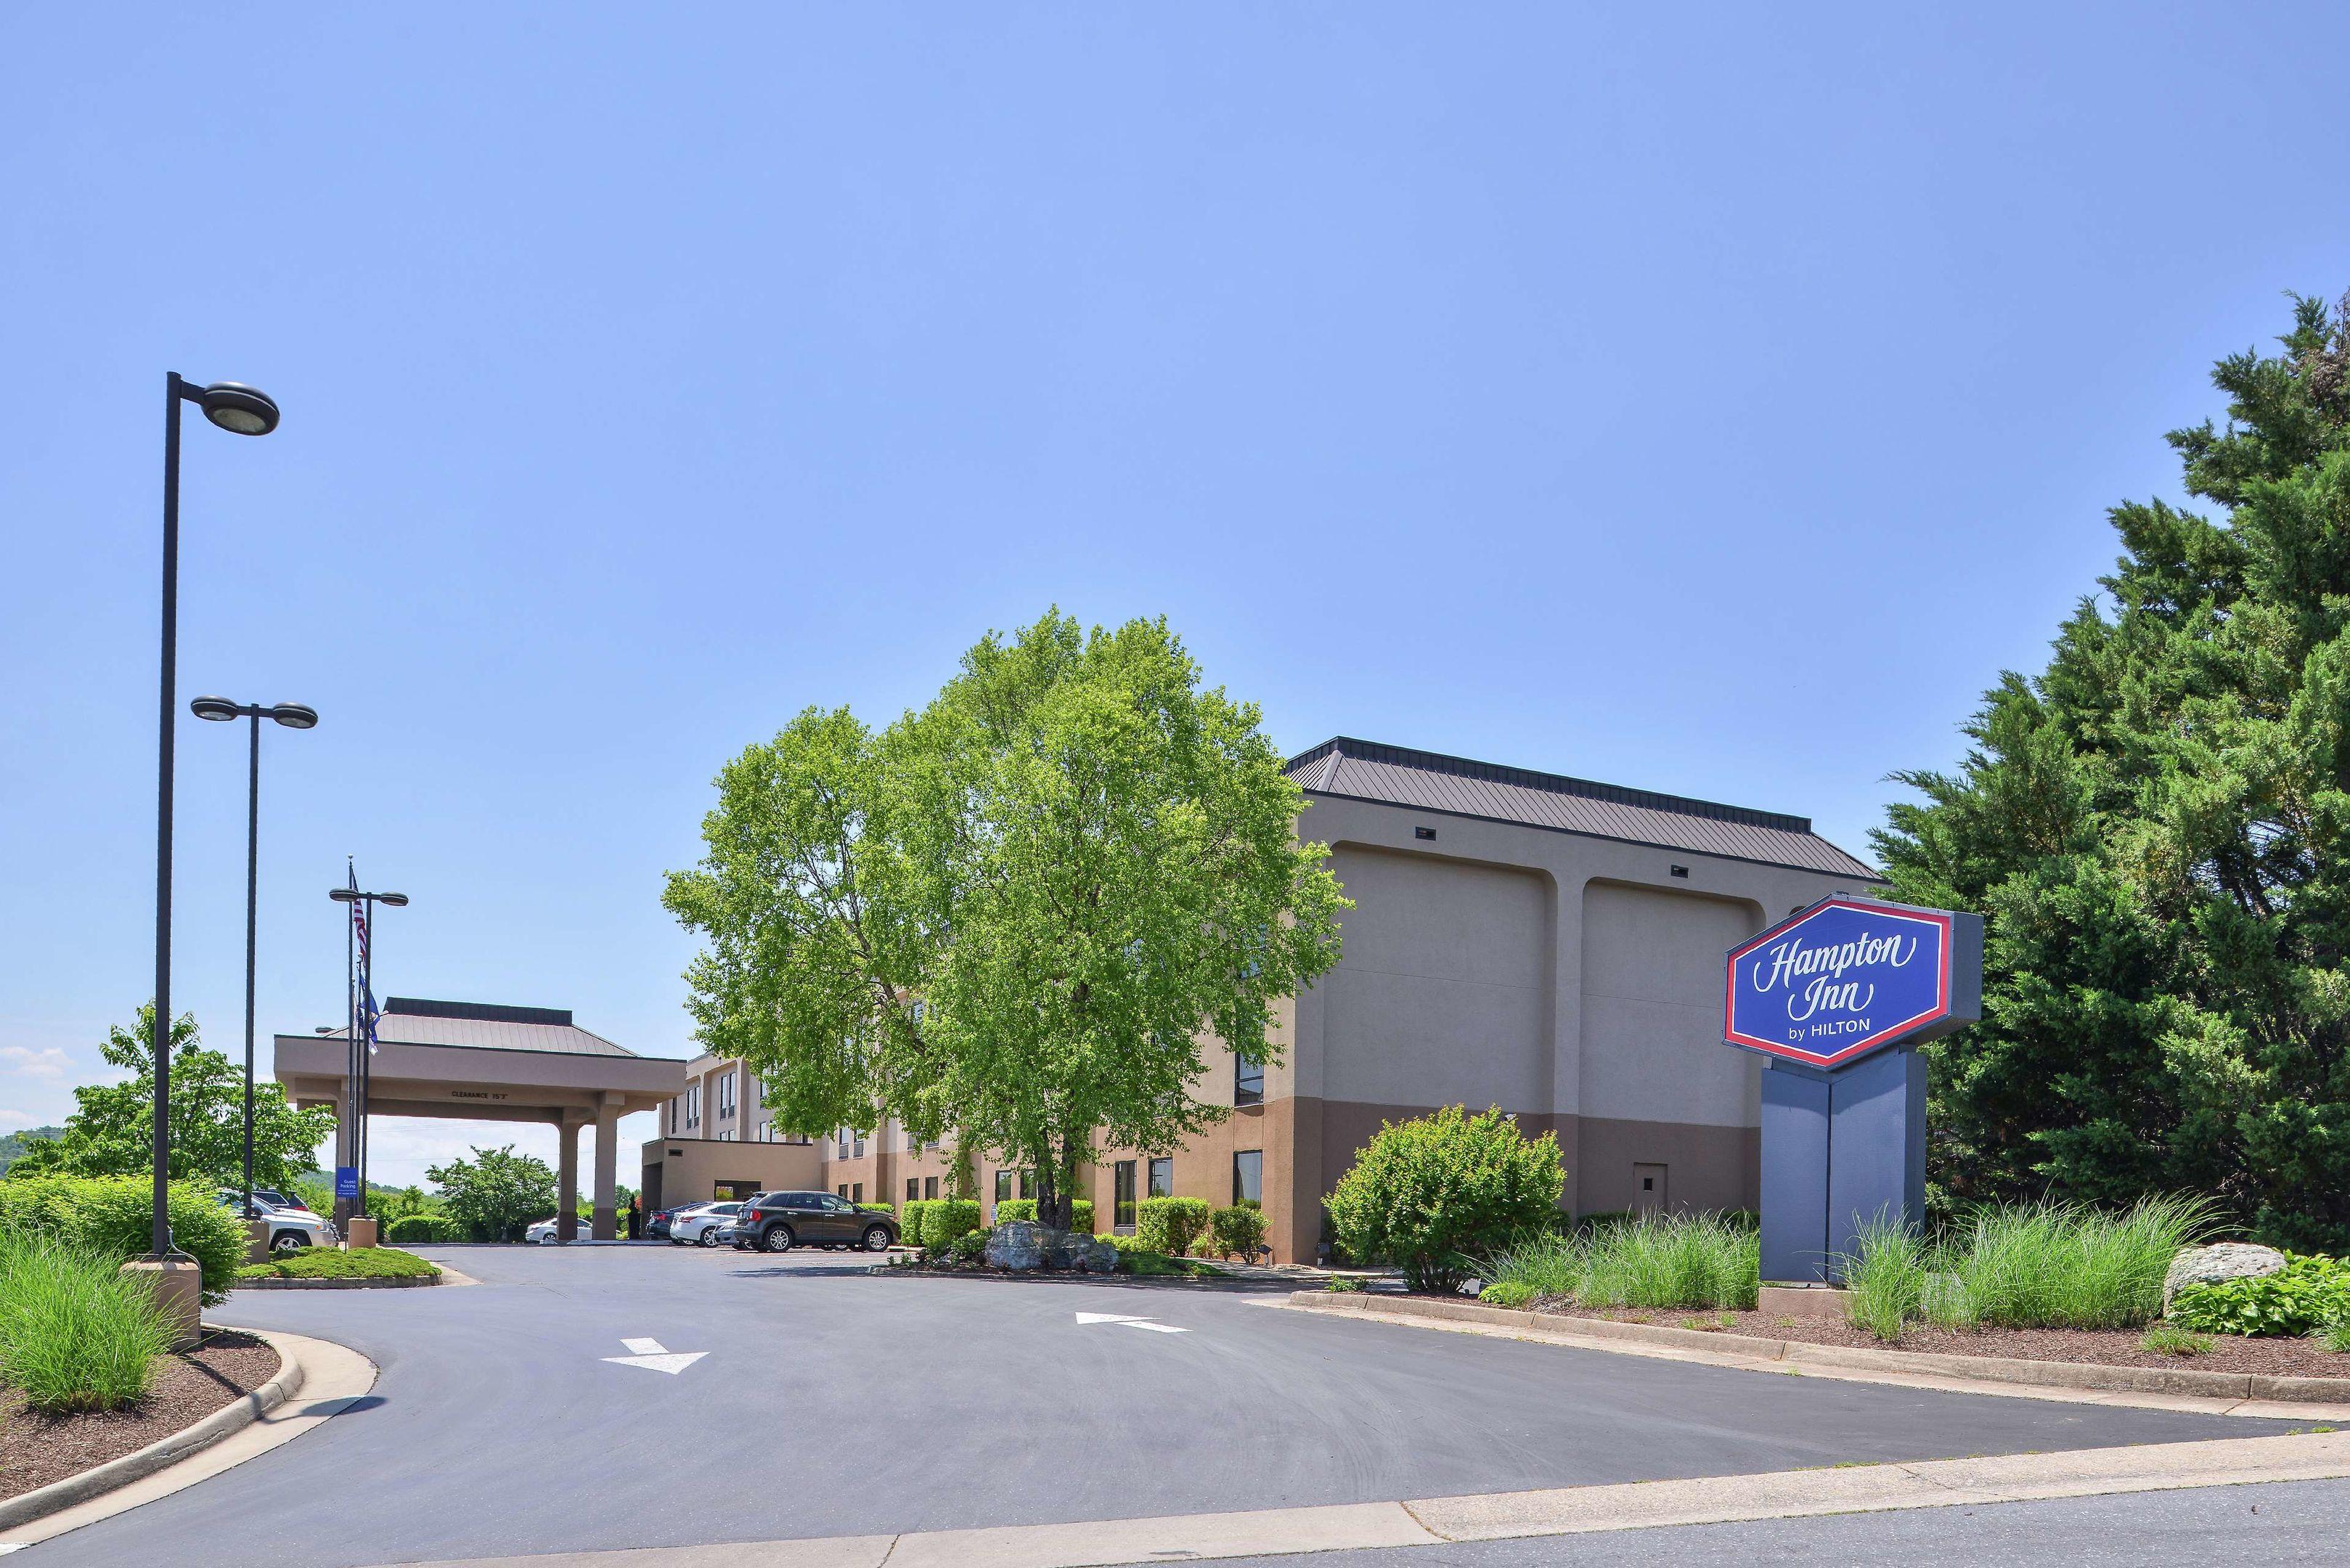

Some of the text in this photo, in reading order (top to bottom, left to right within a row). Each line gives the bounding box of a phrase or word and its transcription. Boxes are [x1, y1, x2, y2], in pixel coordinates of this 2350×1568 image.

[1753, 932, 1917, 992] Hampton
[1787, 975, 1874, 1021] Inn
[1789, 1018, 1870, 1041] by HILTON
